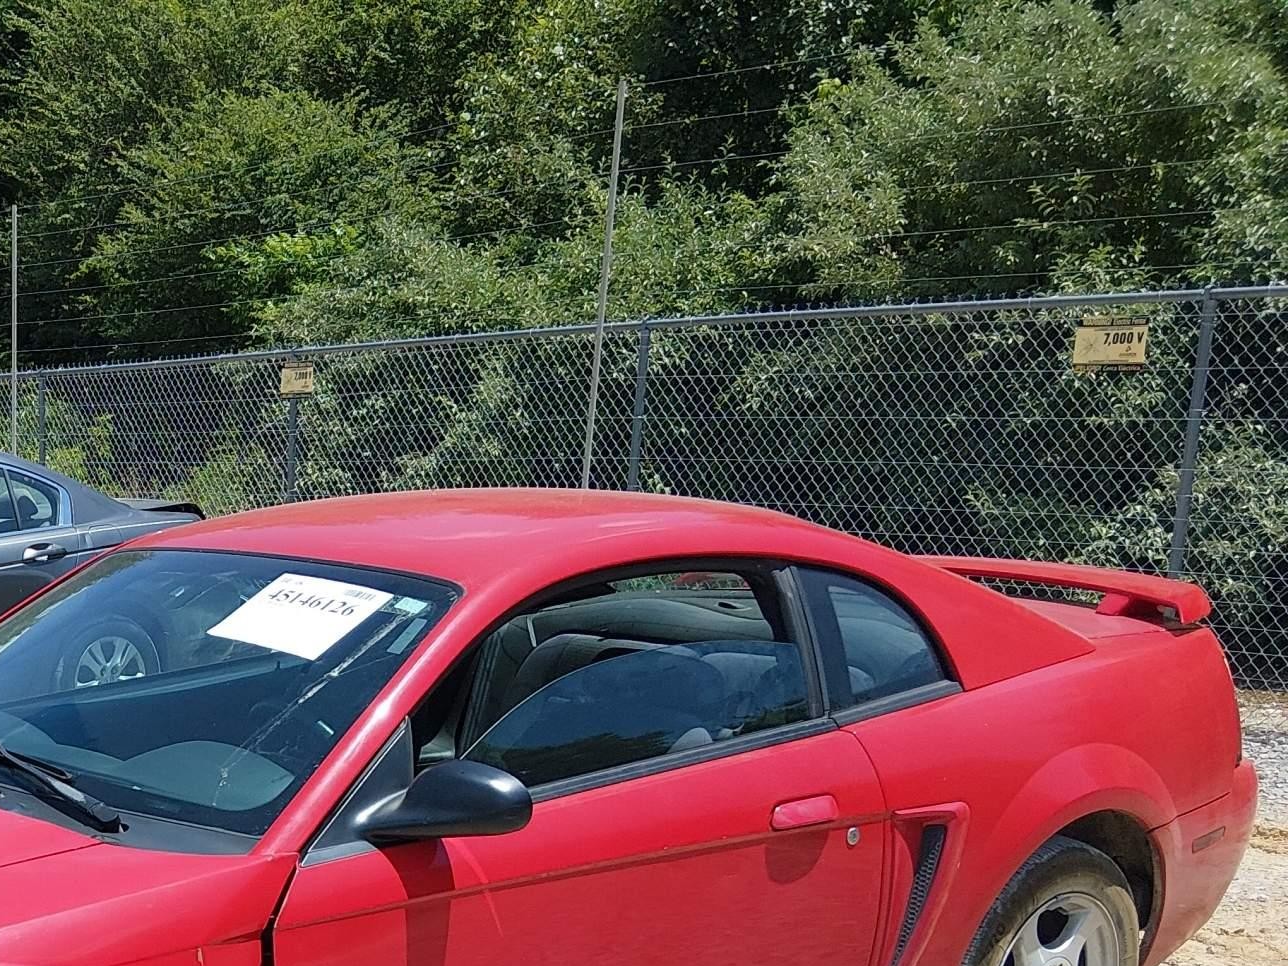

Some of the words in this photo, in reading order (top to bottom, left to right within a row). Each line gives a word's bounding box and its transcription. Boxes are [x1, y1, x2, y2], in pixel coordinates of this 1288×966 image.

[1103, 331, 1134, 346] 7,000
[1137, 331, 1145, 344] V
[269, 588, 356, 617] 45146126
